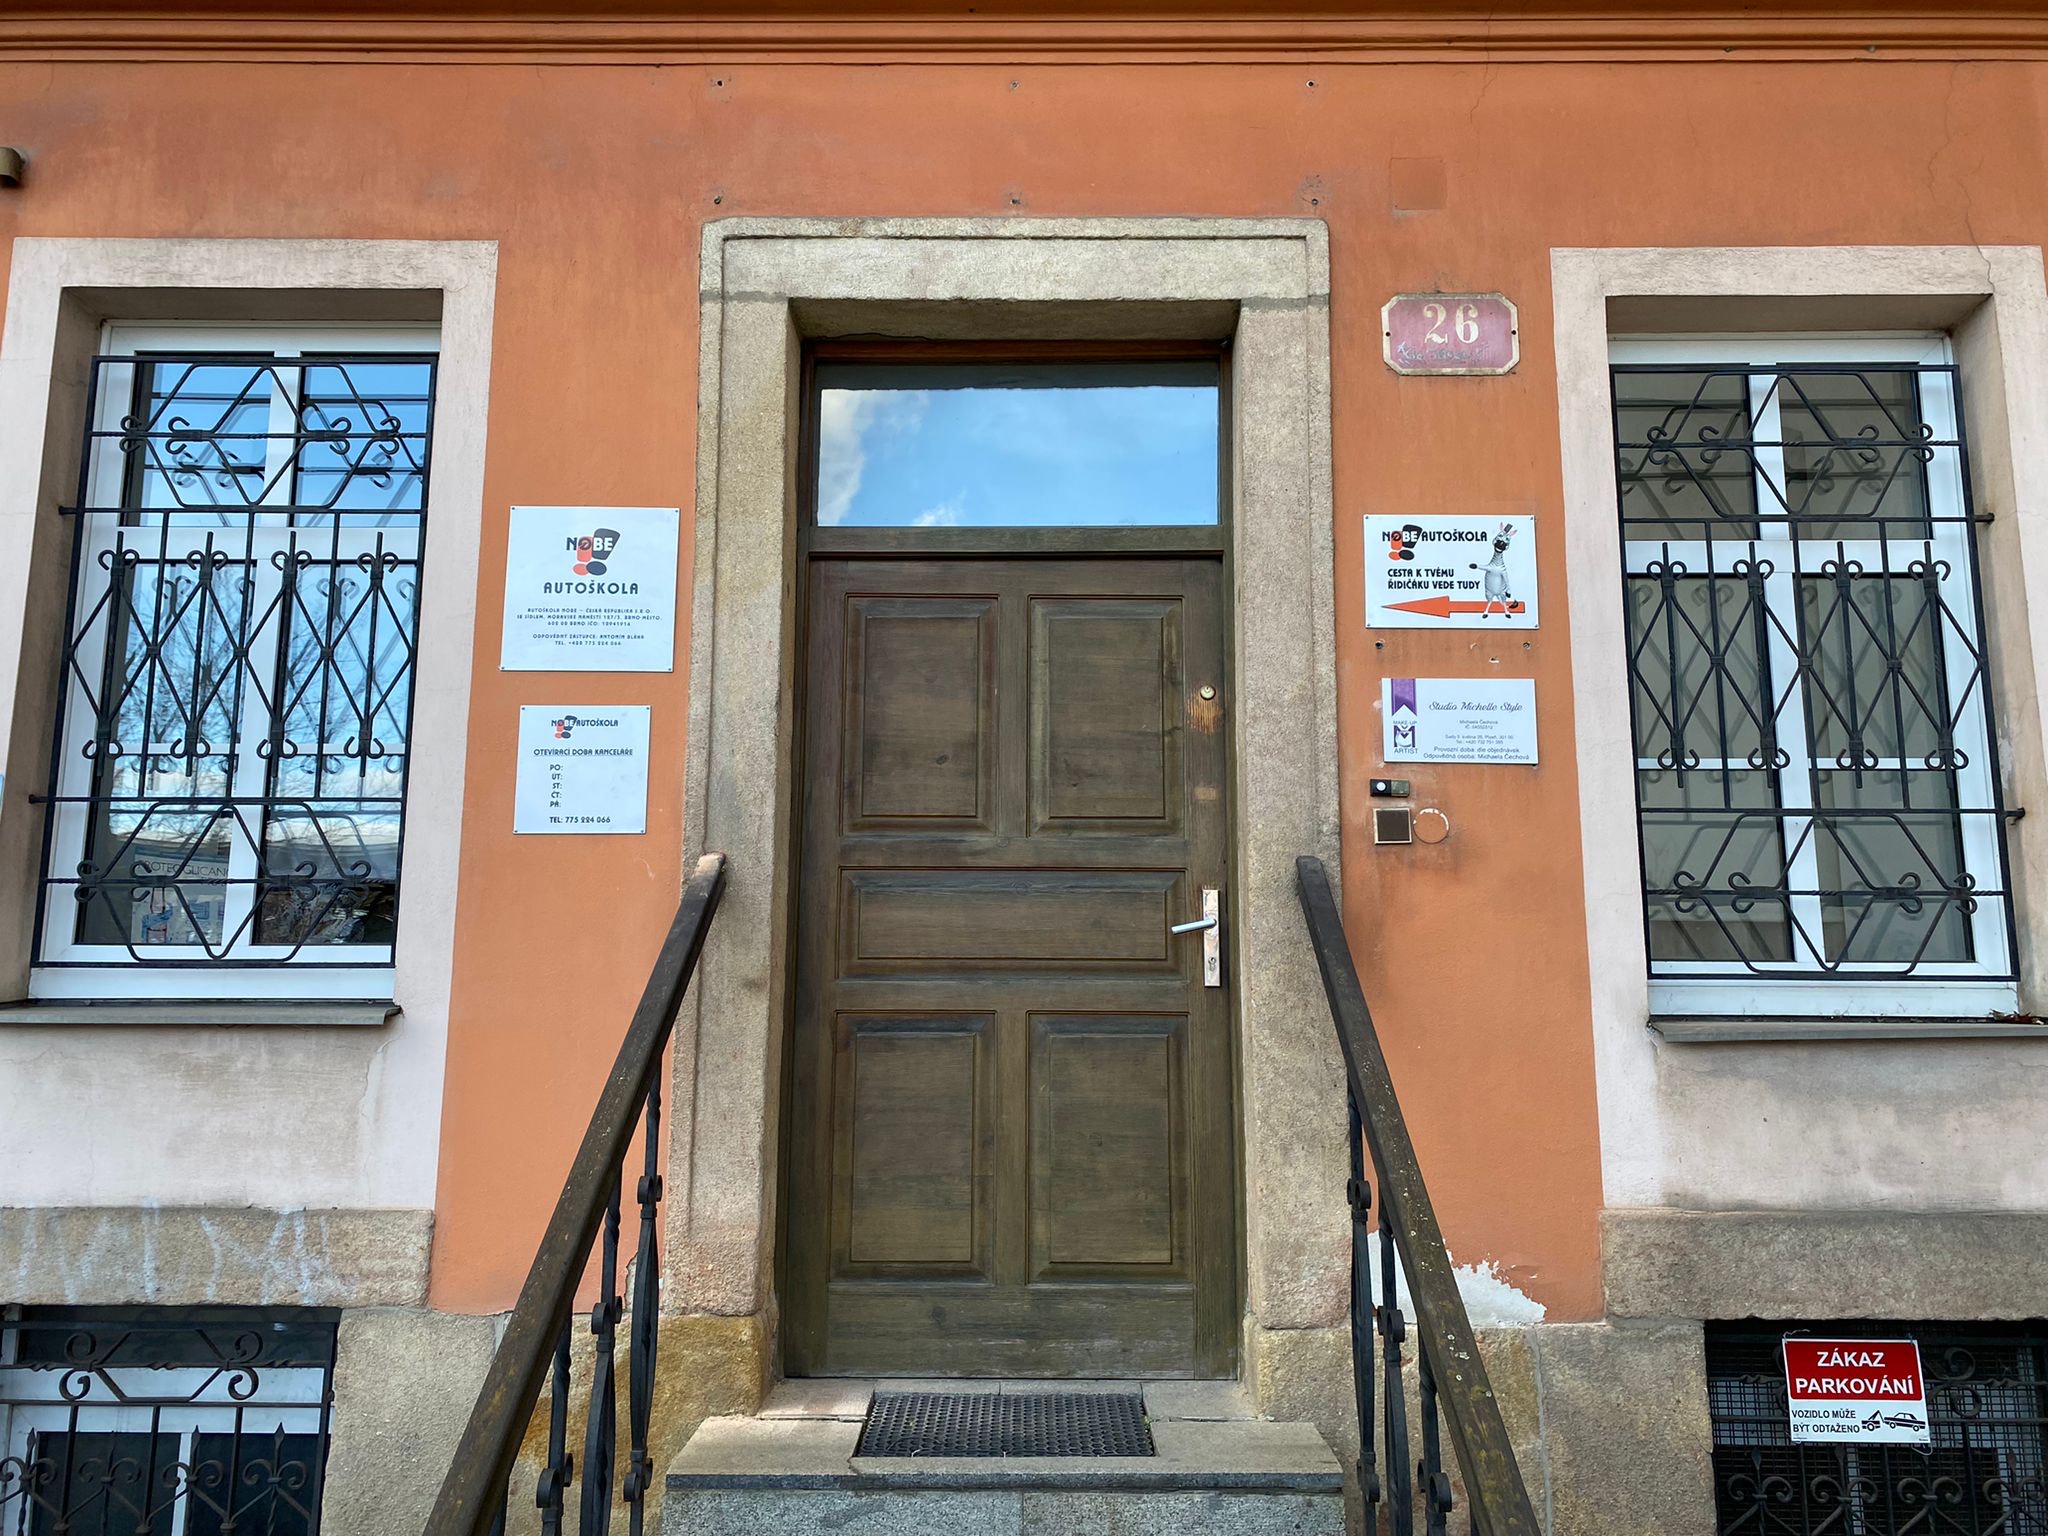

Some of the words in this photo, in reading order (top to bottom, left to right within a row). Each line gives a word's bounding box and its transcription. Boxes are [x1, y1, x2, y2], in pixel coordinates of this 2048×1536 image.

[1423, 303, 1479, 344] 26
[1382, 531, 1418, 542] NOBE
[1421, 529, 1488, 542] AUTOŠKOLA
[566, 537, 613, 551] NOBE
[1387, 568, 1413, 578] CESTA
[1416, 569, 1422, 577] K
[1424, 567, 1454, 578] TVÉMU
[543, 580, 639, 595] AUTOŠKOLA
[1388, 579, 1429, 590] ŘIDIČÁKU
[1432, 580, 1454, 590] VEDE
[1457, 580, 1480, 590] TUDY
[1428, 701, 1457, 711] Studio
[1460, 701, 1498, 711] Michelle
[1500, 701, 1523, 713] Style
[576, 718, 618, 727] AUTOŠKOLA
[533, 747, 570, 756] OTEVÍRACÍ
[572, 748, 593, 756] DOBA
[594, 747, 633, 756] KANCELÁŘE
[1487, 746, 1520, 754] objednávek
[551, 791, 562, 799] ČT:
[565, 816, 579, 824] 775
[580, 816, 594, 824] 224
[596, 816, 611, 824] 066
[1817, 1347, 1886, 1367] ZÁKAZ
[1795, 1375, 1914, 1394] PARKOVÁNÍ
[1791, 1409, 1830, 1419] VOZIDLO
[1832, 1408, 1857, 1419] MŮŽE
[1793, 1422, 1810, 1433] BÝT
[1812, 1422, 1861, 1433] ODTAŽENO
